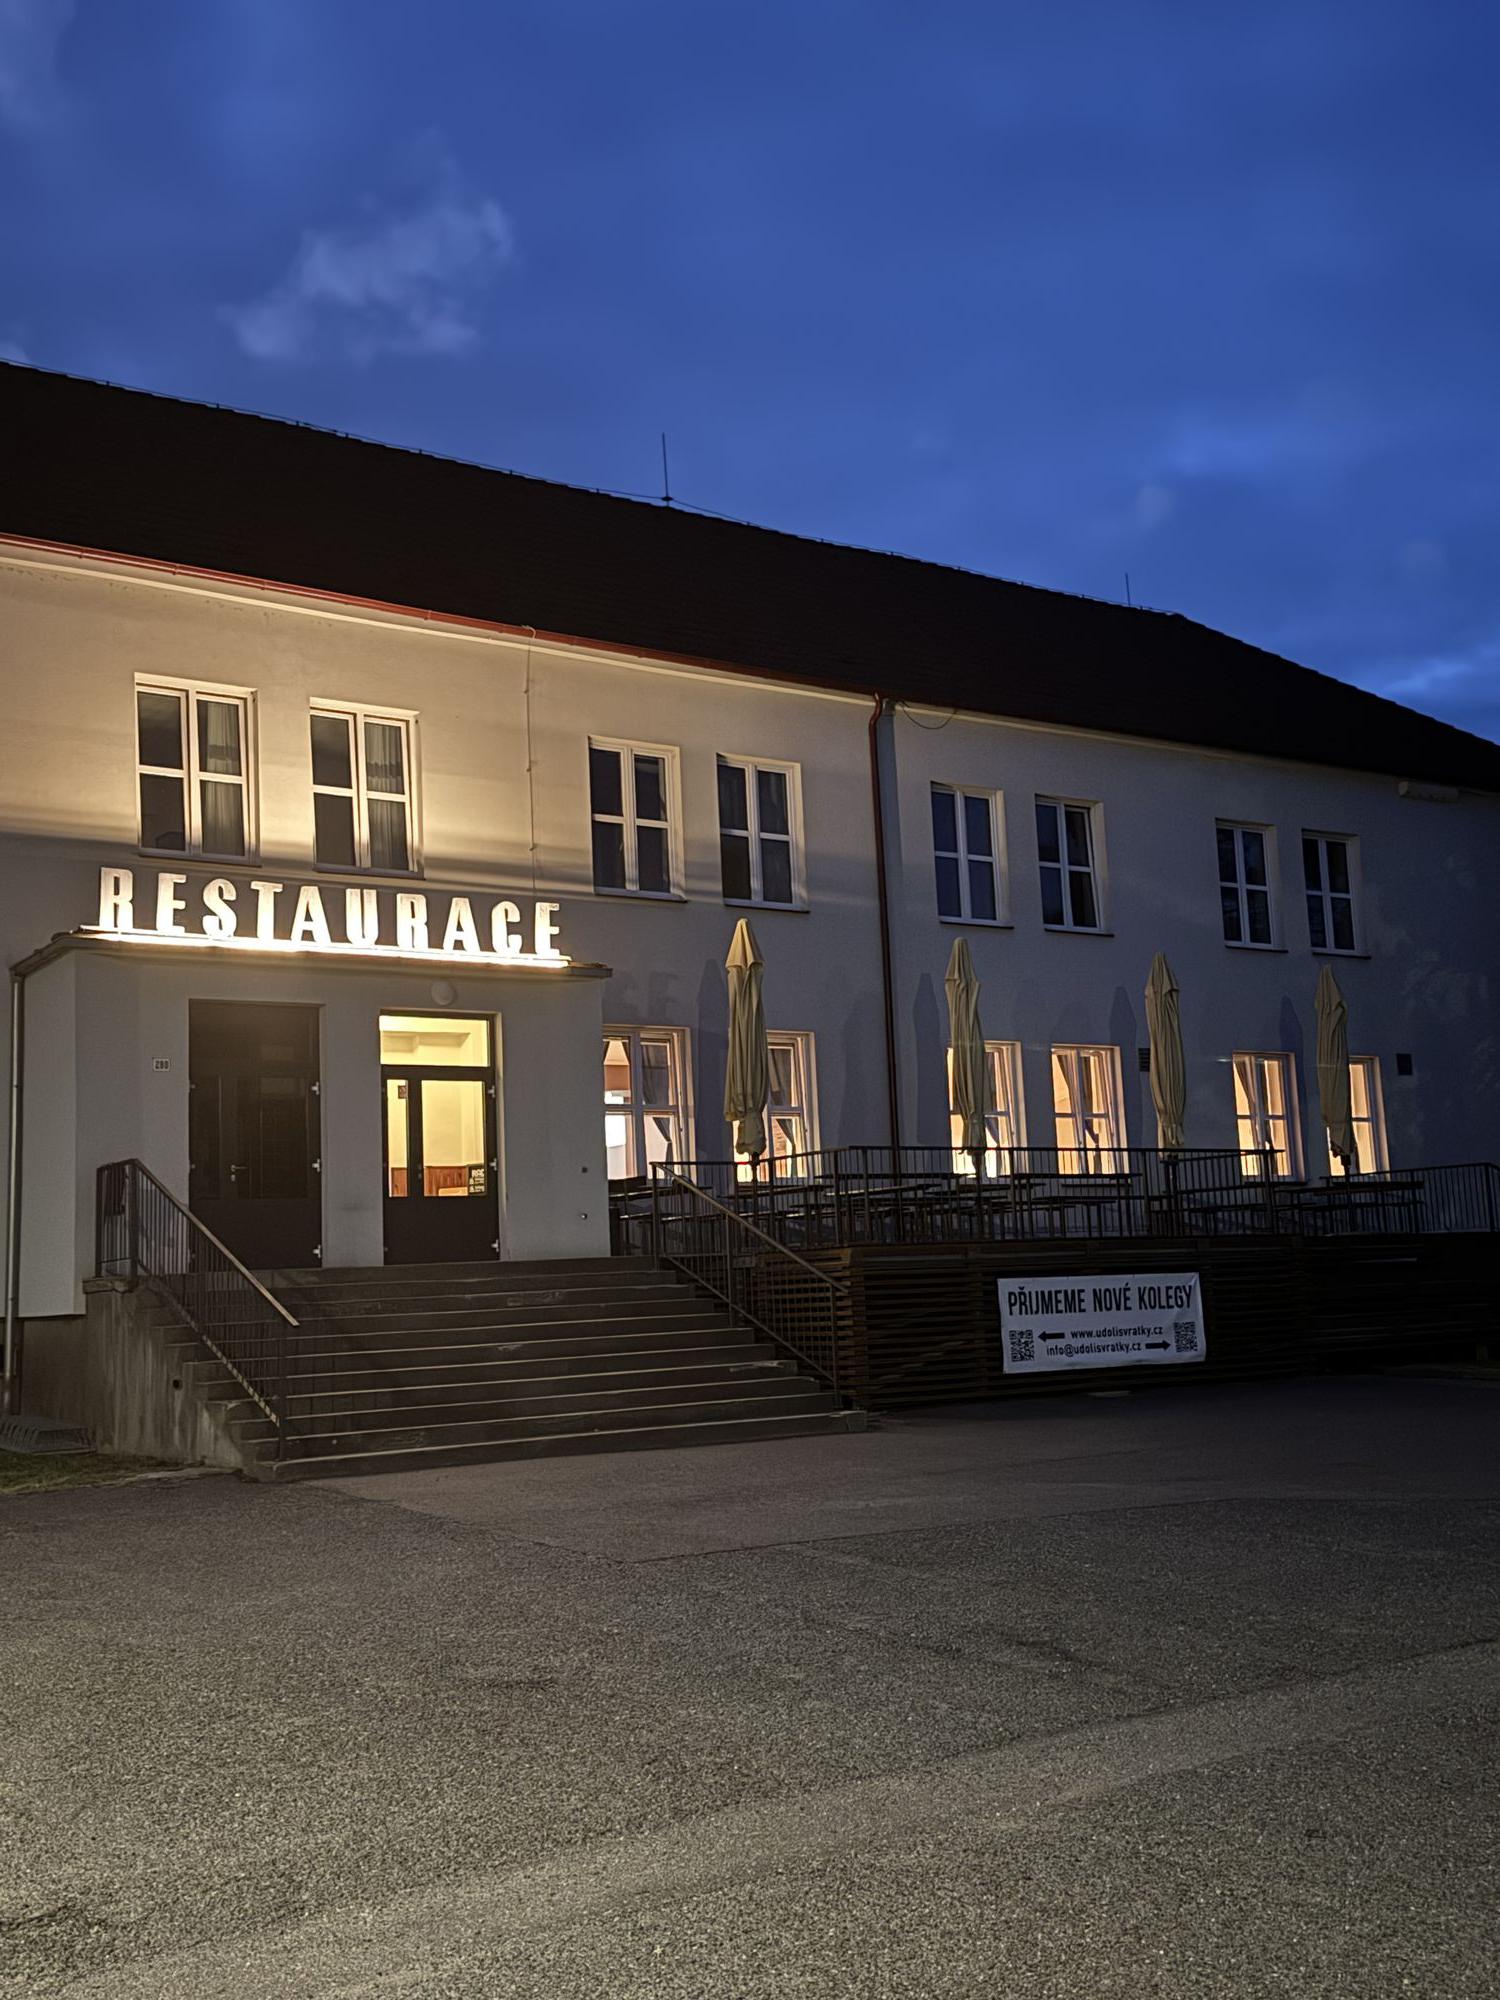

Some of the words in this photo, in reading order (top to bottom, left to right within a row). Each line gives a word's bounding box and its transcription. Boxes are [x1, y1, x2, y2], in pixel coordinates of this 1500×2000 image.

[99, 866, 561, 957] RESTAURACE
[1007, 1286, 1086, 1316] PŘIJMEME
[1093, 1283, 1132, 1312] NOVÉ
[1138, 1284, 1193, 1311] KOLEGY
[1070, 1325, 1163, 1339] www.udolisvratky.cz
[1046, 1342, 1142, 1357] info@udolisvratky.cz
